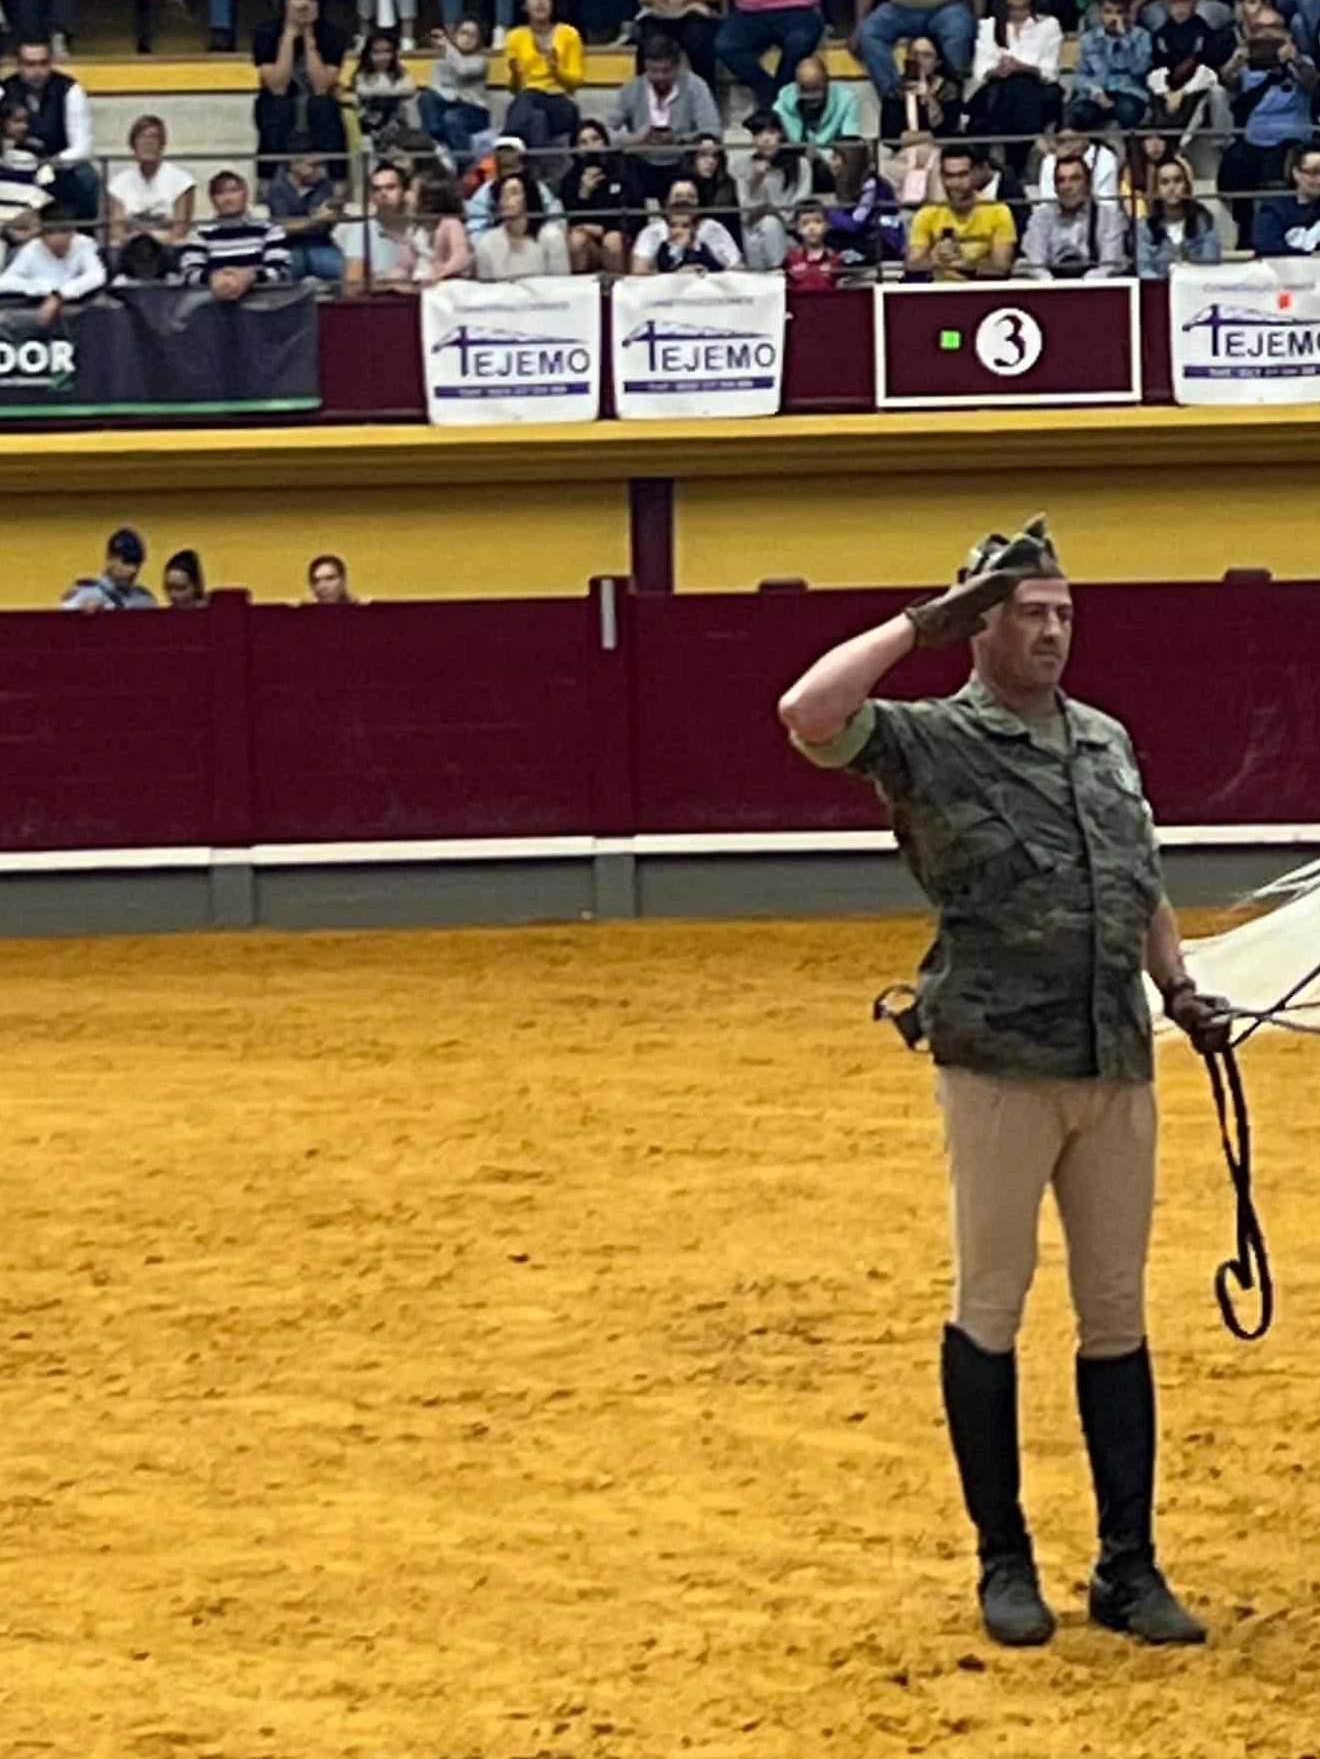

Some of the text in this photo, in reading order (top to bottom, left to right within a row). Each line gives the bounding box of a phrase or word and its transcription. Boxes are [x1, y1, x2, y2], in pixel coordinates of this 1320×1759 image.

[456, 325, 591, 378] TEJEMO
[643, 320, 776, 373] TEJEMO
[993, 313, 1026, 368] 3
